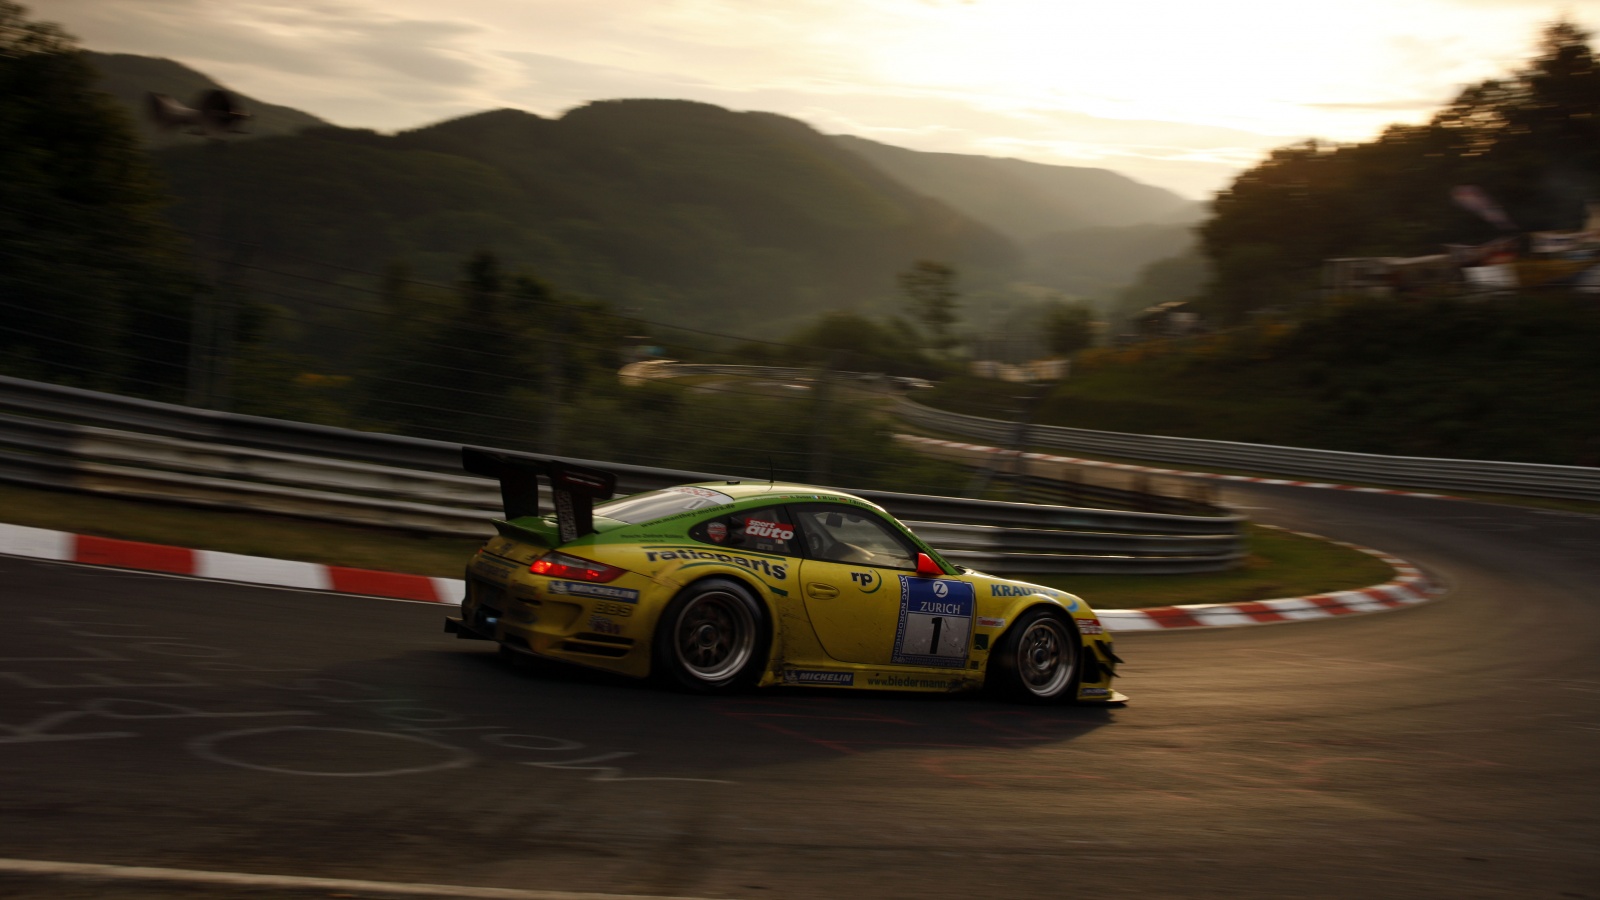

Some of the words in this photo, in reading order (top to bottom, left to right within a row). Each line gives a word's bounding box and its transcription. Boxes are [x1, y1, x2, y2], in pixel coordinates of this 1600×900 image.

[749, 519, 776, 529] sport
[745, 526, 794, 540] auto
[646, 550, 787, 580] ratioparts
[851, 571, 873, 586] rp
[569, 583, 637, 600] MICHELIN
[900, 576, 908, 600] ADAC
[920, 601, 961, 614] ZURICH
[931, 617, 943, 654] 1
[800, 672, 852, 682] MICHELIN
